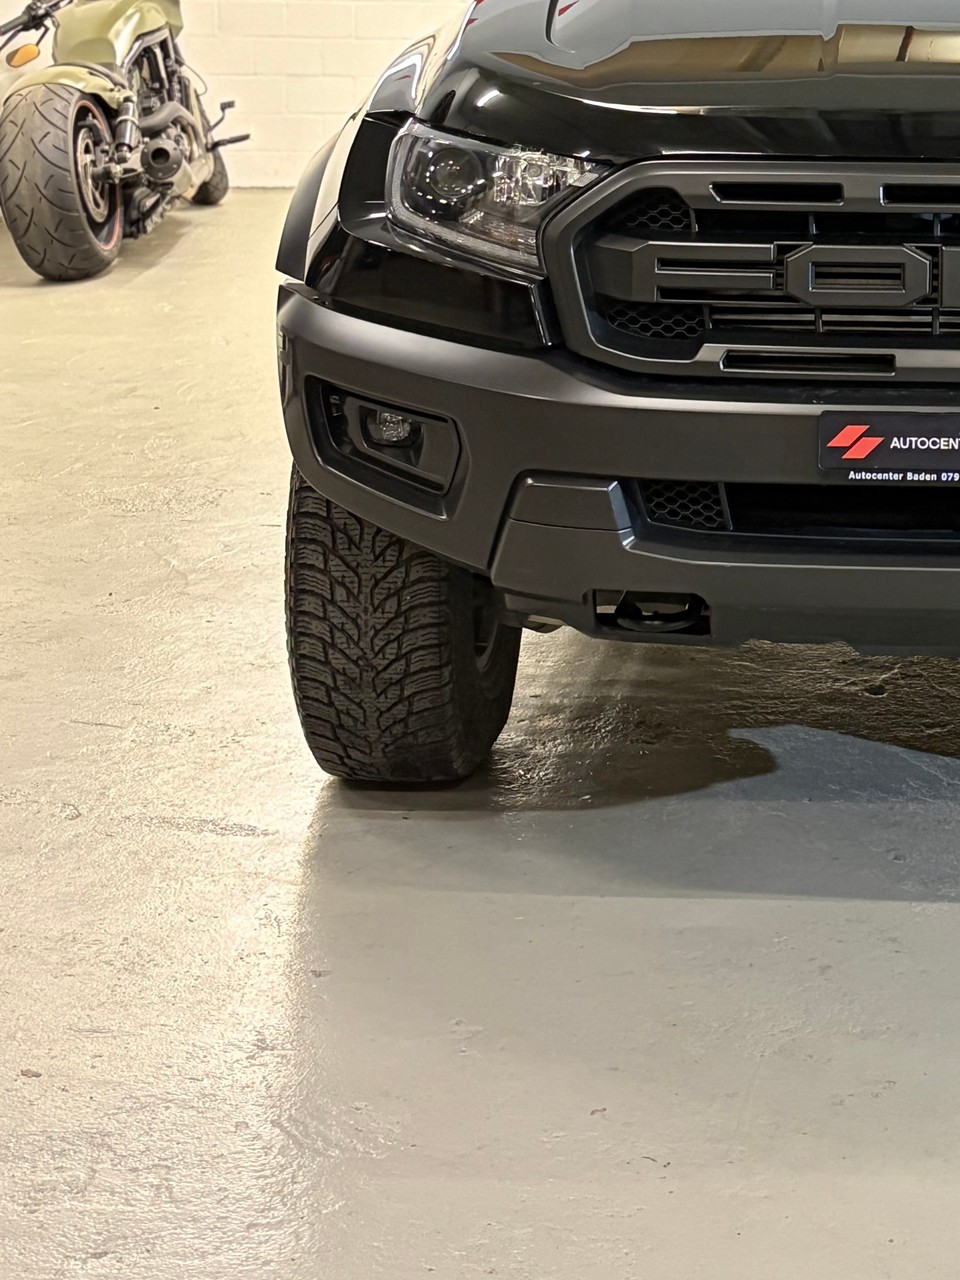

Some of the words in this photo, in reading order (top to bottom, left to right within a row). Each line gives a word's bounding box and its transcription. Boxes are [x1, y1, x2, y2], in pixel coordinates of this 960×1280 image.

[848, 470, 904, 481] Autocenter
[906, 471, 937, 482] Baden
[940, 472, 960, 482] 079
